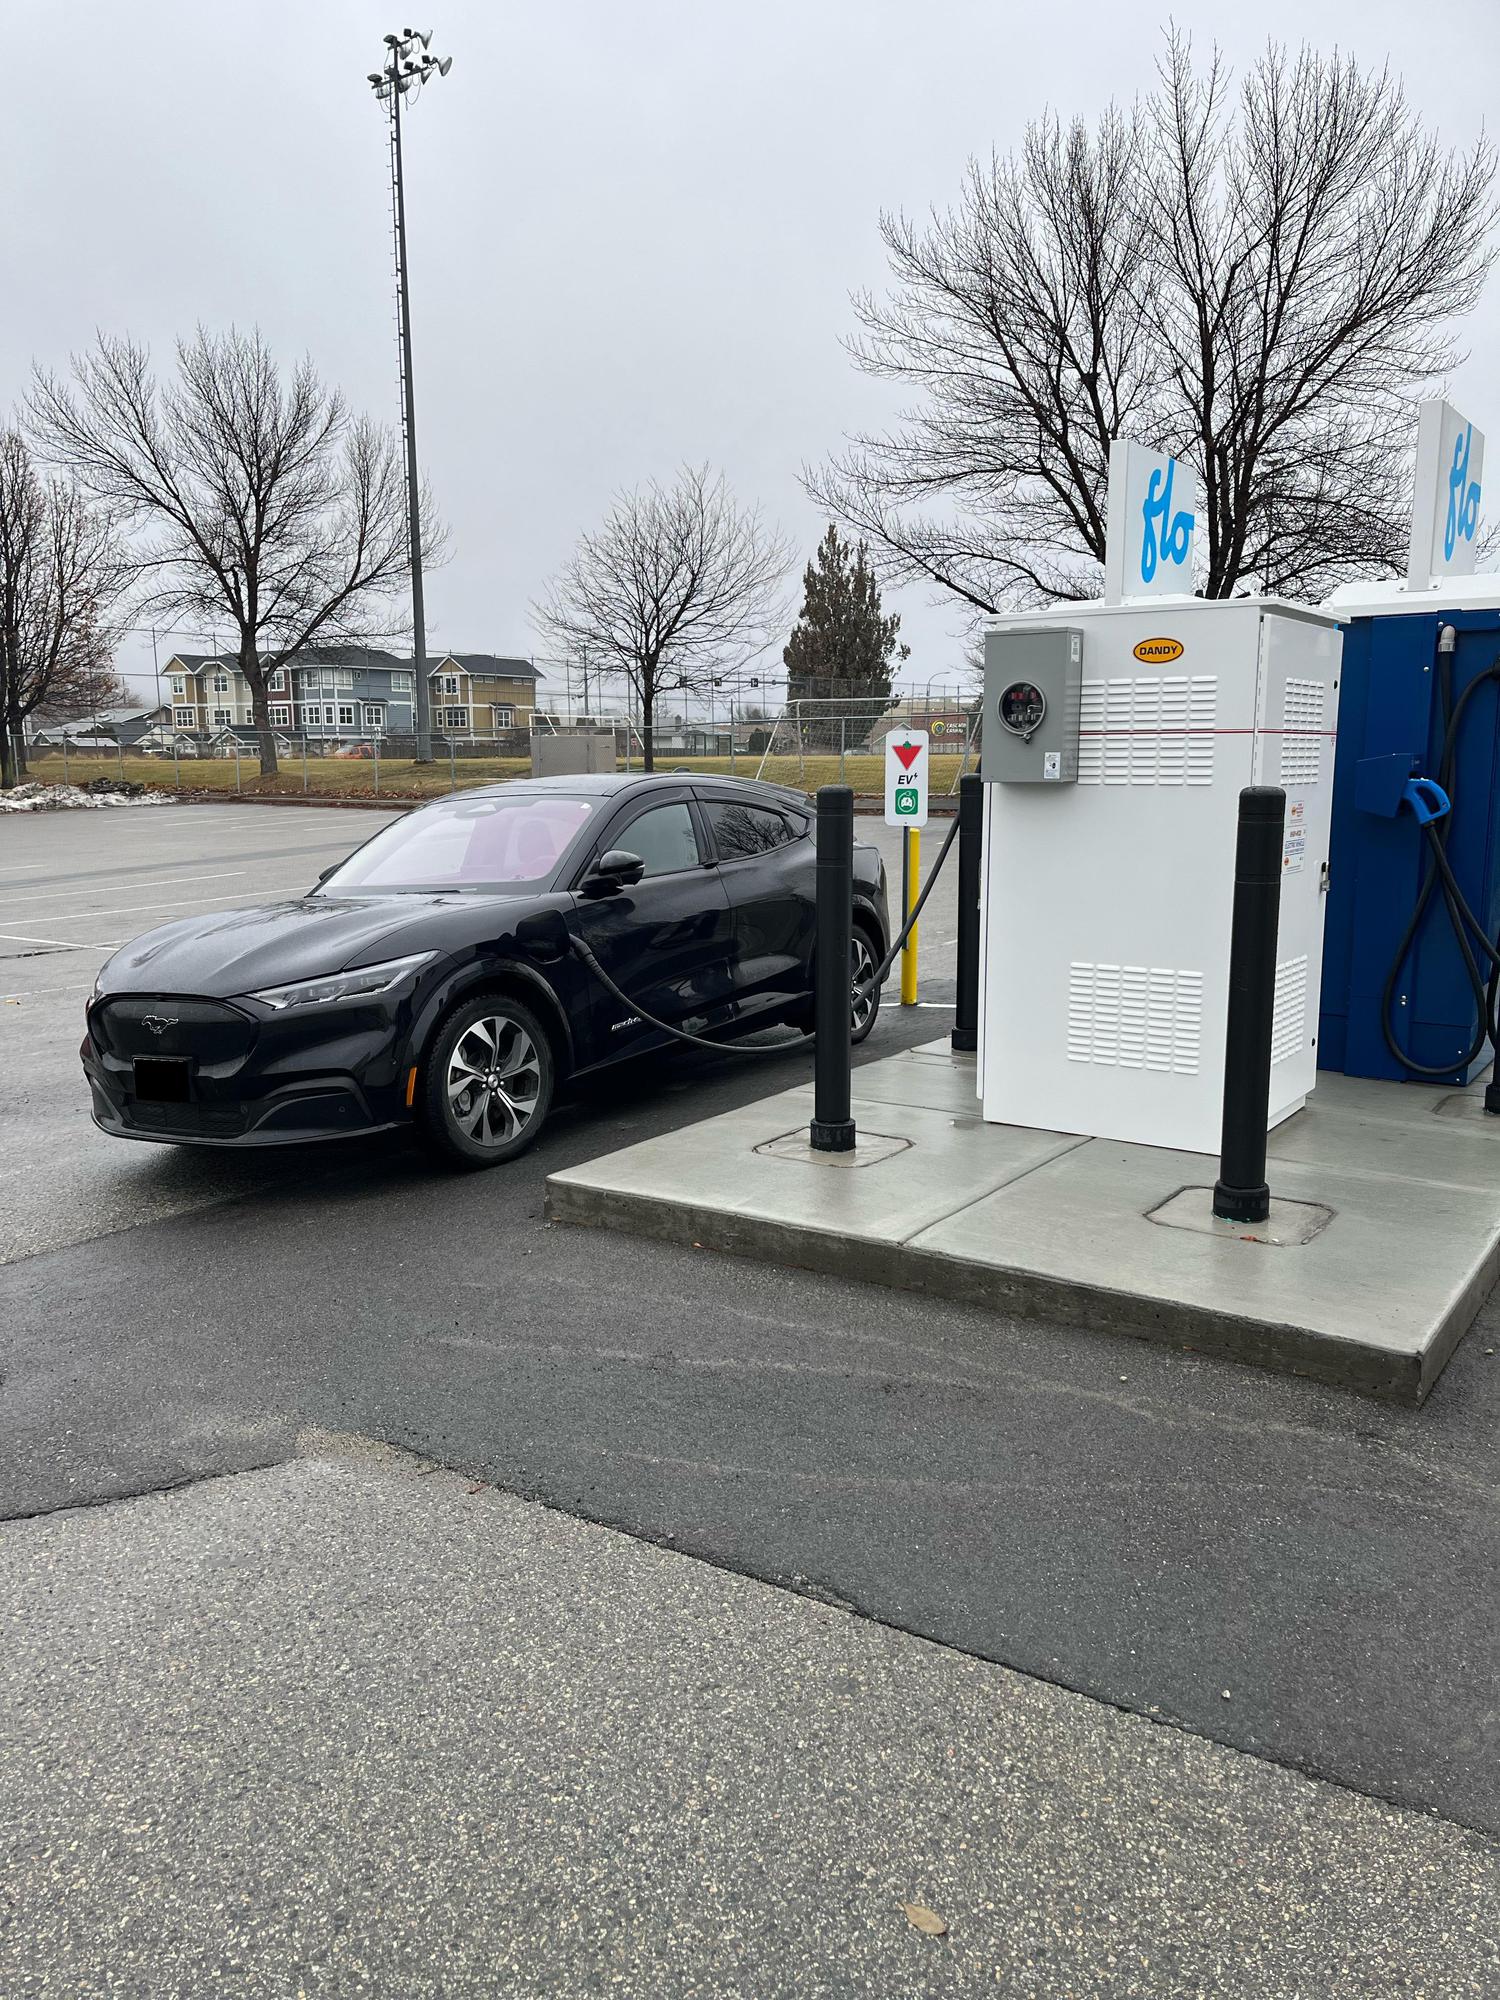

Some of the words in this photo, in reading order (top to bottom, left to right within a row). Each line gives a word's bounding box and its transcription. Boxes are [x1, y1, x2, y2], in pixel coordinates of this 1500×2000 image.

[1141, 457, 1195, 584] flo
[1445, 412, 1482, 562] flo
[1139, 645, 1178, 656] DANDY
[897, 774, 914, 785] EV
